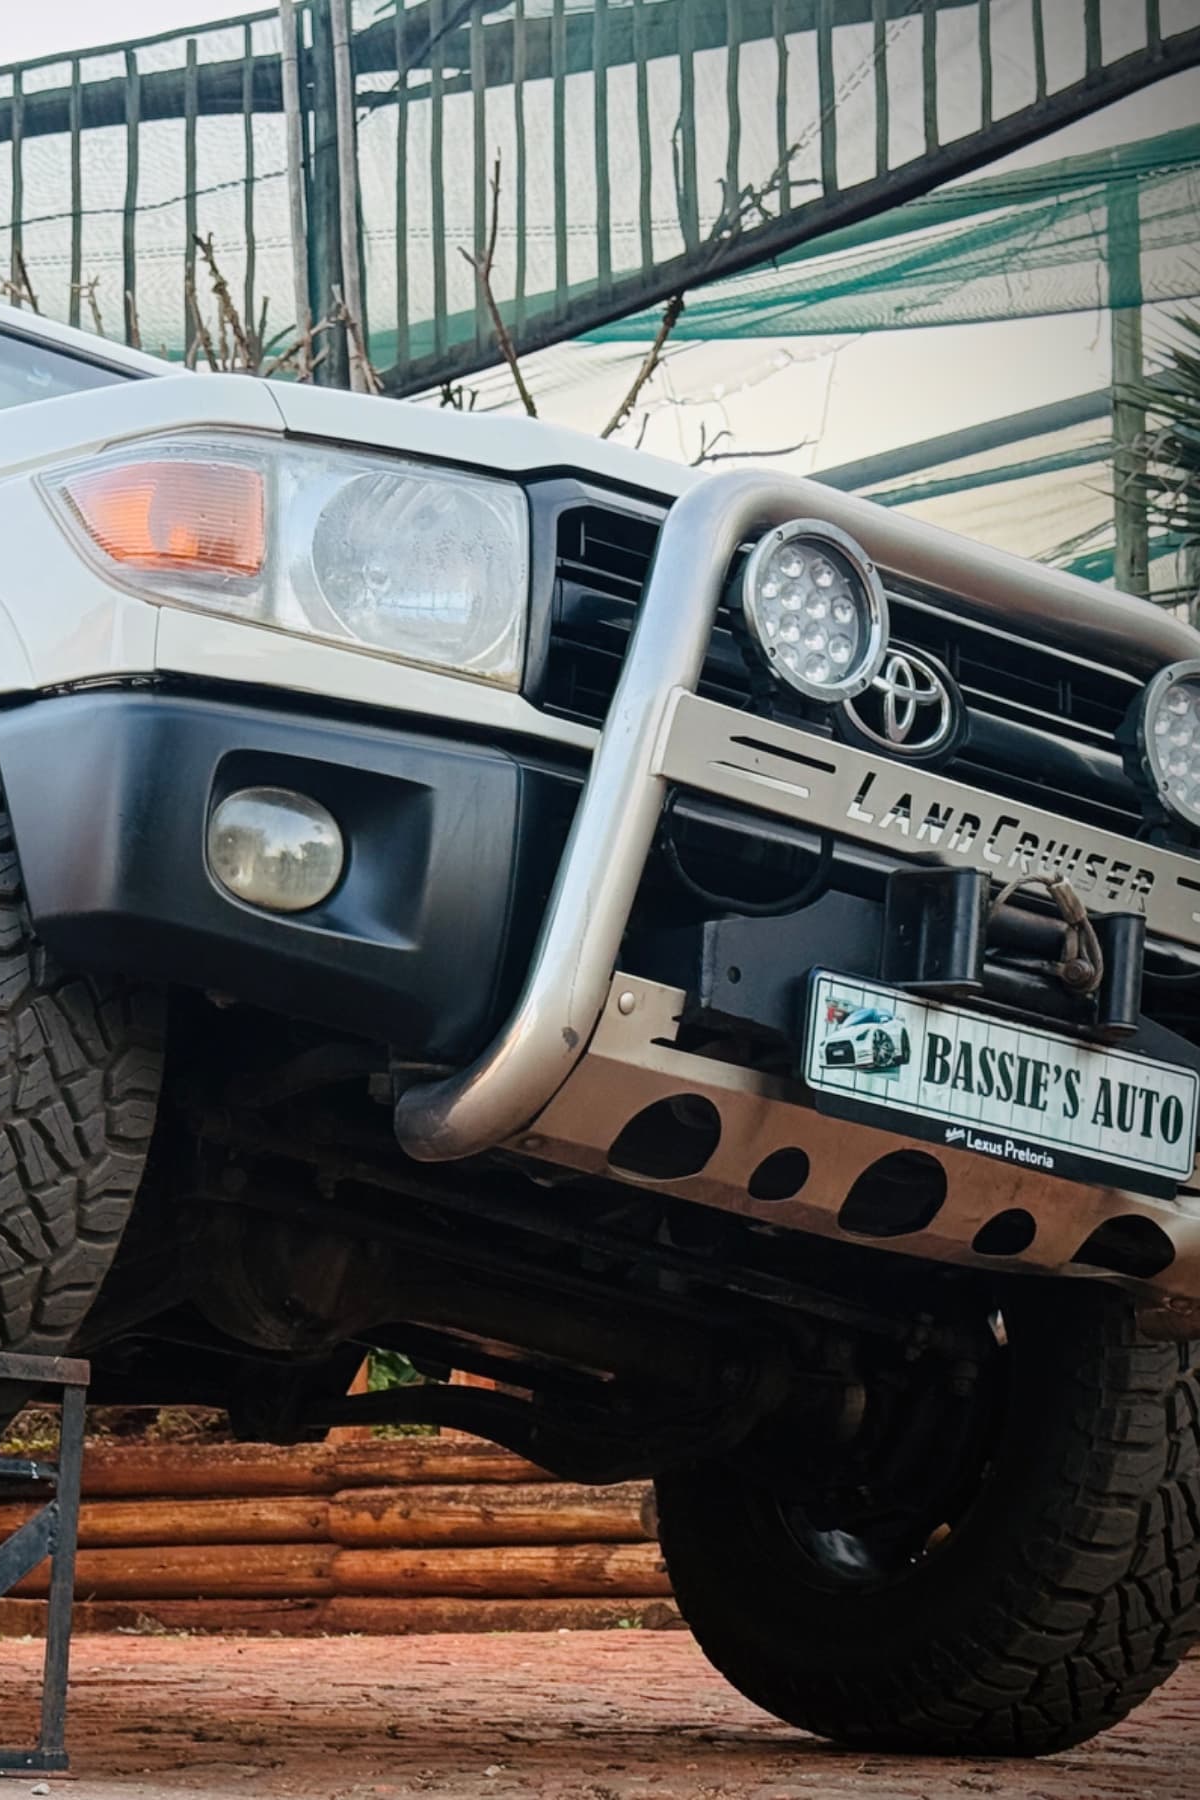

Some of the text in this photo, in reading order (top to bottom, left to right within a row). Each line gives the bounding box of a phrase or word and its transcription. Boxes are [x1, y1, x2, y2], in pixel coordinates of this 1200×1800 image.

[922, 1031, 1184, 1145] BASSIE'S AUTO
[966, 1130, 1003, 1158] Lexus
[1004, 1142, 1054, 1169] Pretoria
